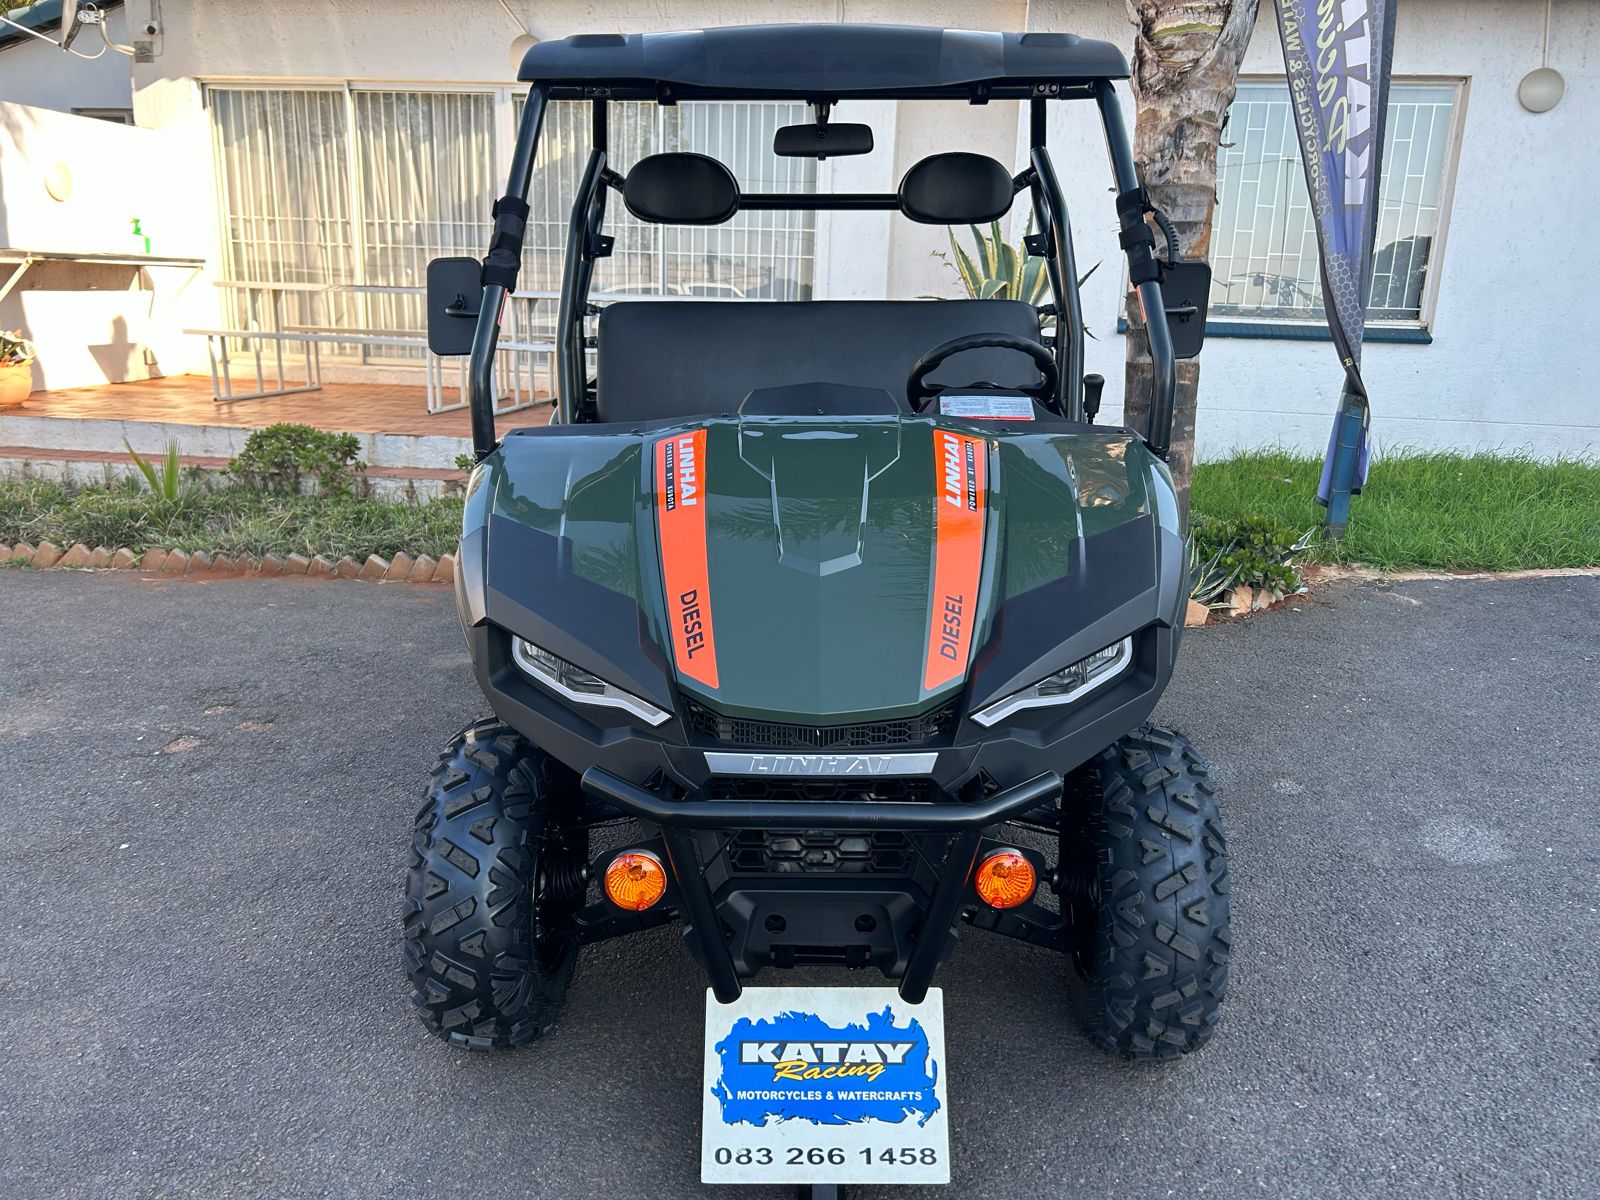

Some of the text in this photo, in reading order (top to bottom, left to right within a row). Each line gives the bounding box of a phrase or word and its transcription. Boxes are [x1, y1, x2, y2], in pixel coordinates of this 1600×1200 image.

[966, 442, 974, 463] KUBOTA
[679, 438, 697, 506] LINHAI
[944, 434, 961, 508] LINHAI
[968, 467, 975, 475] BY
[680, 589, 705, 660] DIESEL
[940, 594, 963, 661] DIESEL
[749, 756, 892, 774] LINHAI
[741, 1042, 914, 1064] KATAY
[773, 1060, 886, 1082] Racing
[737, 1090, 922, 1101] MOTORCYCLES & WATERCRAFTS
[714, 1148, 937, 1165] 083 266 1458
